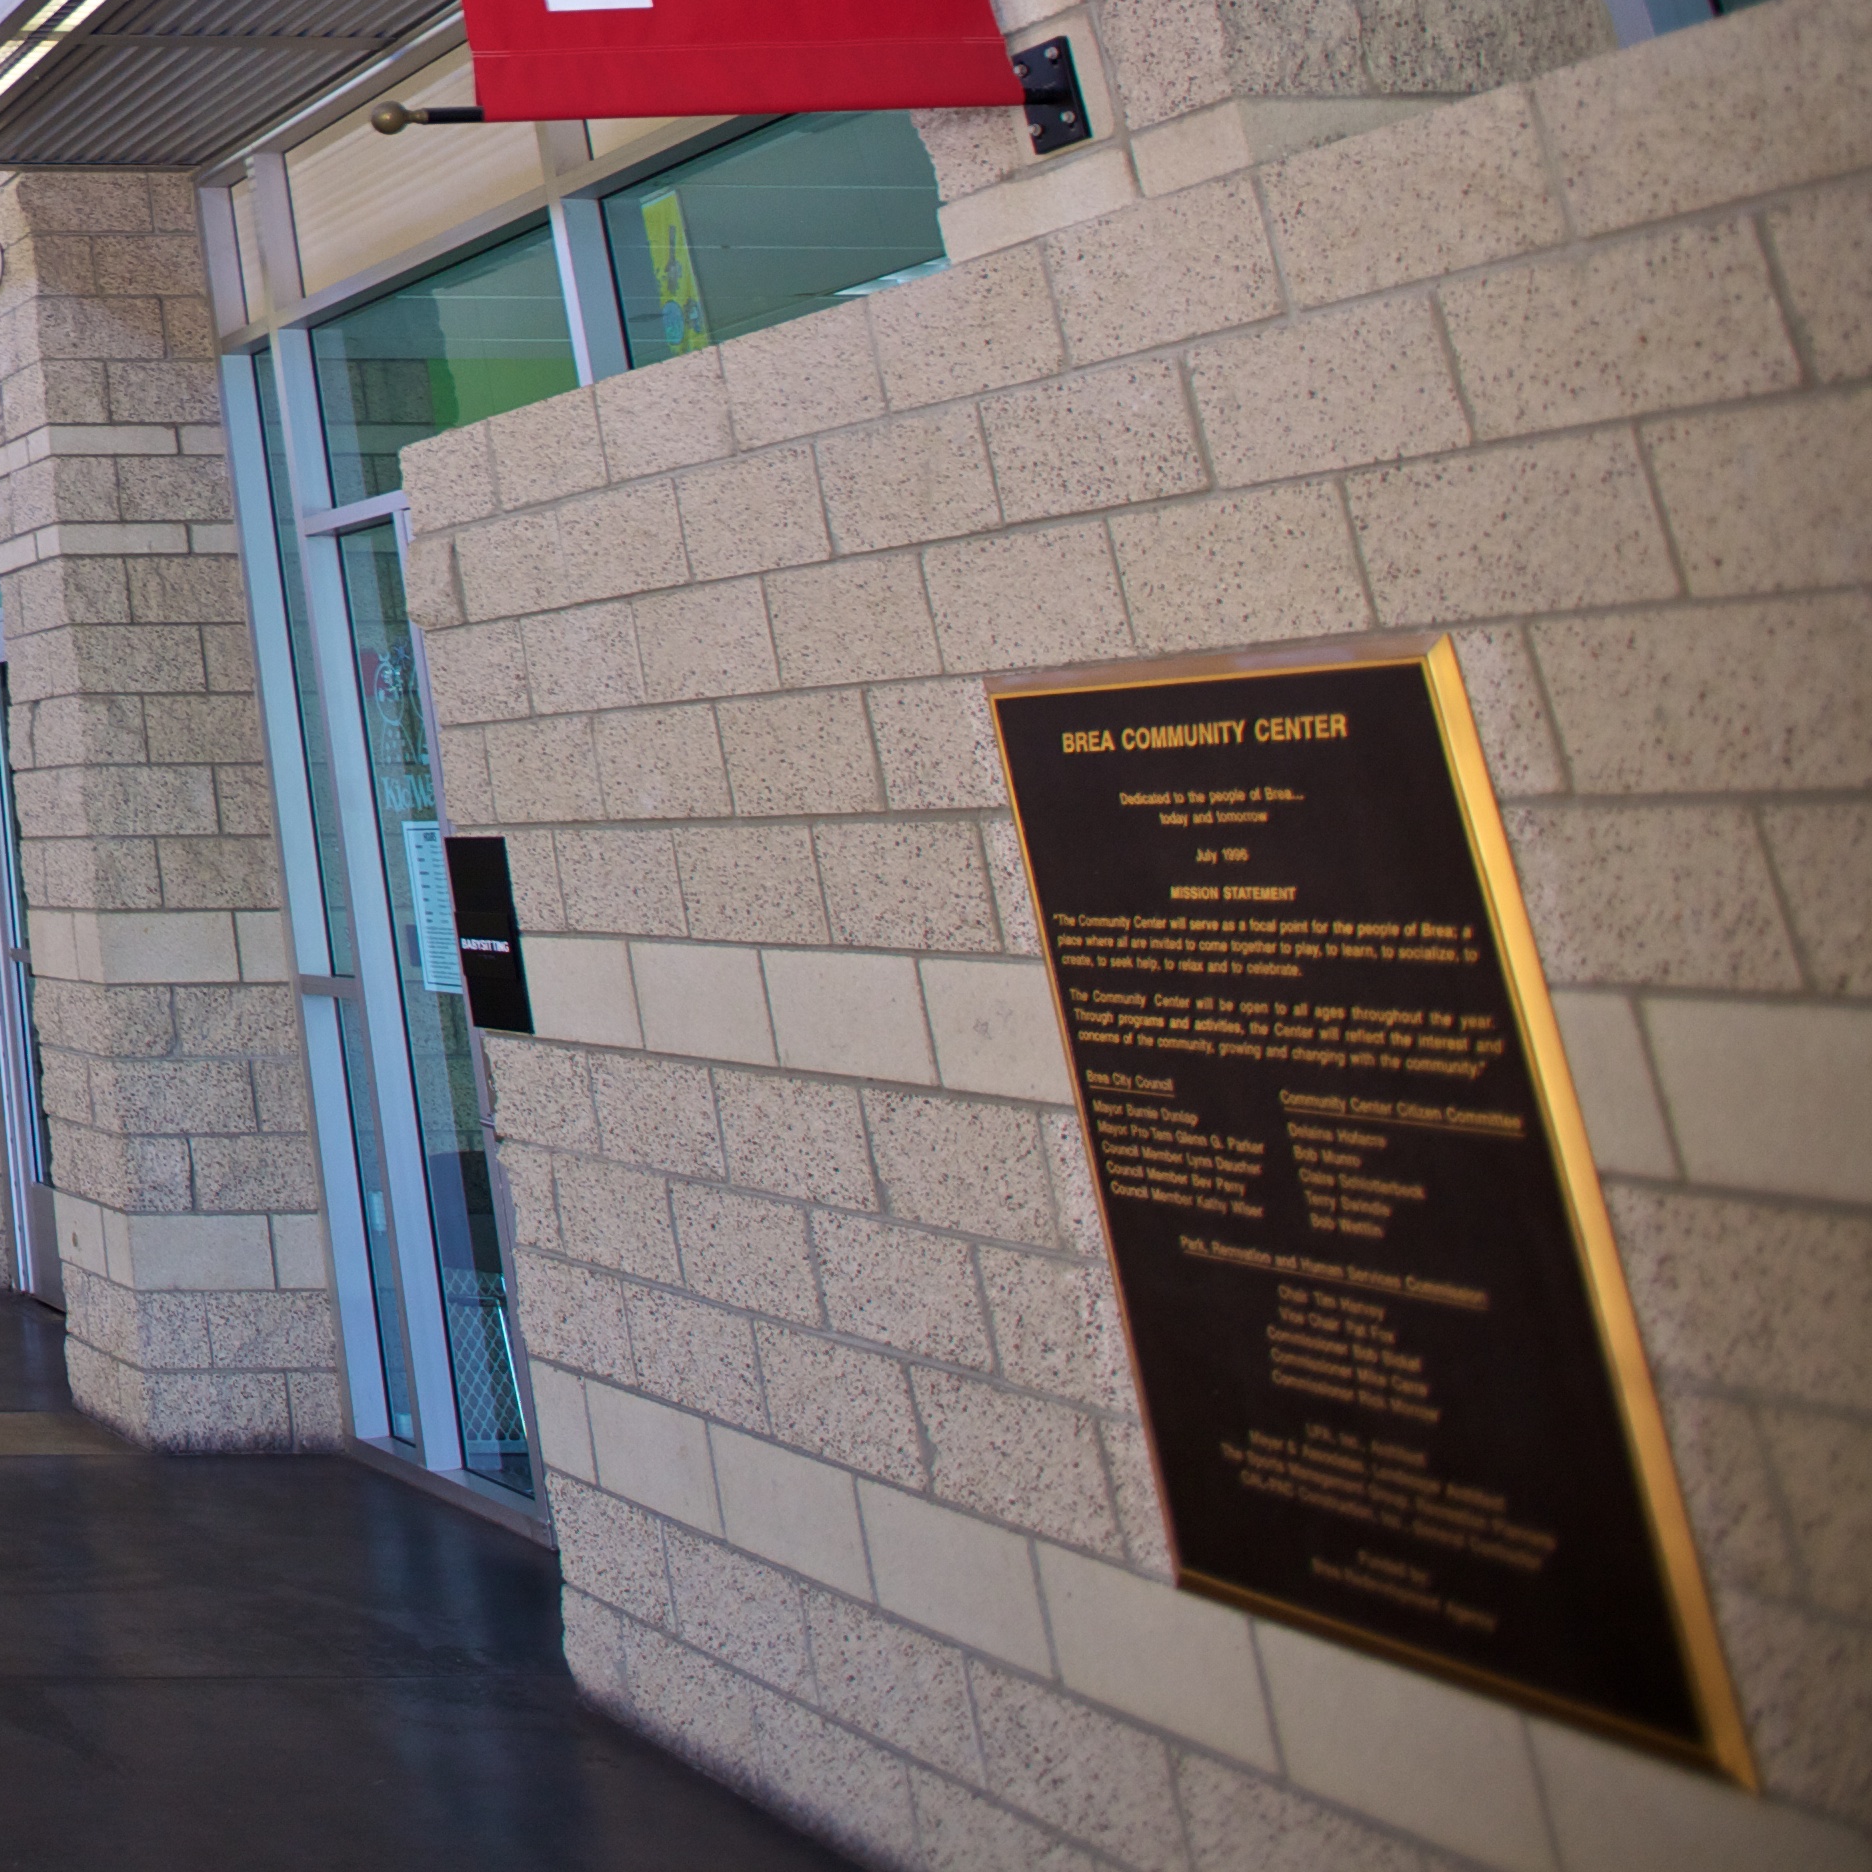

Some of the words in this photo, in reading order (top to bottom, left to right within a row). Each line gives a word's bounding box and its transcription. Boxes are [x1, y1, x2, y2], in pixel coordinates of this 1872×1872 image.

[1062, 729, 1115, 753] BREA
[1121, 719, 1246, 751] COMMUNITY
[1254, 713, 1348, 742] CENTER
[1120, 790, 1171, 806] Dedicated
[1173, 791, 1185, 804] to
[1187, 790, 1205, 804] the
[1209, 788, 1246, 805] people
[1249, 787, 1262, 802] of
[1160, 812, 1188, 827] today
[1193, 811, 1213, 824] and
[1216, 811, 1268, 824] tomorrow
[1195, 848, 1218, 864] July
[1170, 886, 1219, 900] MISSION
[1223, 886, 1297, 901] STATEMENT
[1078, 914, 1131, 930] Community
[1134, 915, 1167, 930] Center
[1169, 917, 1187, 931] will
[1189, 919, 1219, 932] serve
[1222, 920, 1236, 932] as
[1249, 918, 1277, 933] focal
[1279, 920, 1308, 936] point
[1311, 920, 1329, 934] for
[1333, 921, 1354, 936] the
[1357, 922, 1401, 938] people
[1403, 922, 1418, 937] of
[461, 937, 510, 953] BABYSITTING
[1057, 935, 1083, 948] place
[1085, 935, 1114, 948] where
[1117, 935, 1128, 948] all
[1130, 937, 1147, 950] are
[1149, 937, 1183, 951] invited
[1185, 938, 1196, 951] to
[1198, 940, 1228, 952] come
[1231, 940, 1277, 955] together
[1280, 942, 1292, 955] to
[1325, 943, 1338, 957] to
[1381, 945, 1395, 959] to
[1463, 947, 1479, 963] to
[1097, 955, 1107, 968] to
[1110, 956, 1134, 969] seek
[1164, 958, 1175, 971] to
[1178, 958, 1204, 972] relax
[1207, 960, 1228, 973] and
[1231, 960, 1243, 974] to
[1069, 988, 1089, 1003] The
[1092, 989, 1147, 1008] Community
[1154, 993, 1191, 1009] Center
[1195, 996, 1214, 1010] will
[1219, 997, 1235, 1012] be
[1239, 1001, 1270, 1016] open
[1274, 1001, 1288, 1016] to
[1293, 1001, 1308, 1017] all
[1314, 1006, 1346, 1022] ages
[1351, 1005, 1424, 1026] throughout
[1430, 1010, 1453, 1027] the
